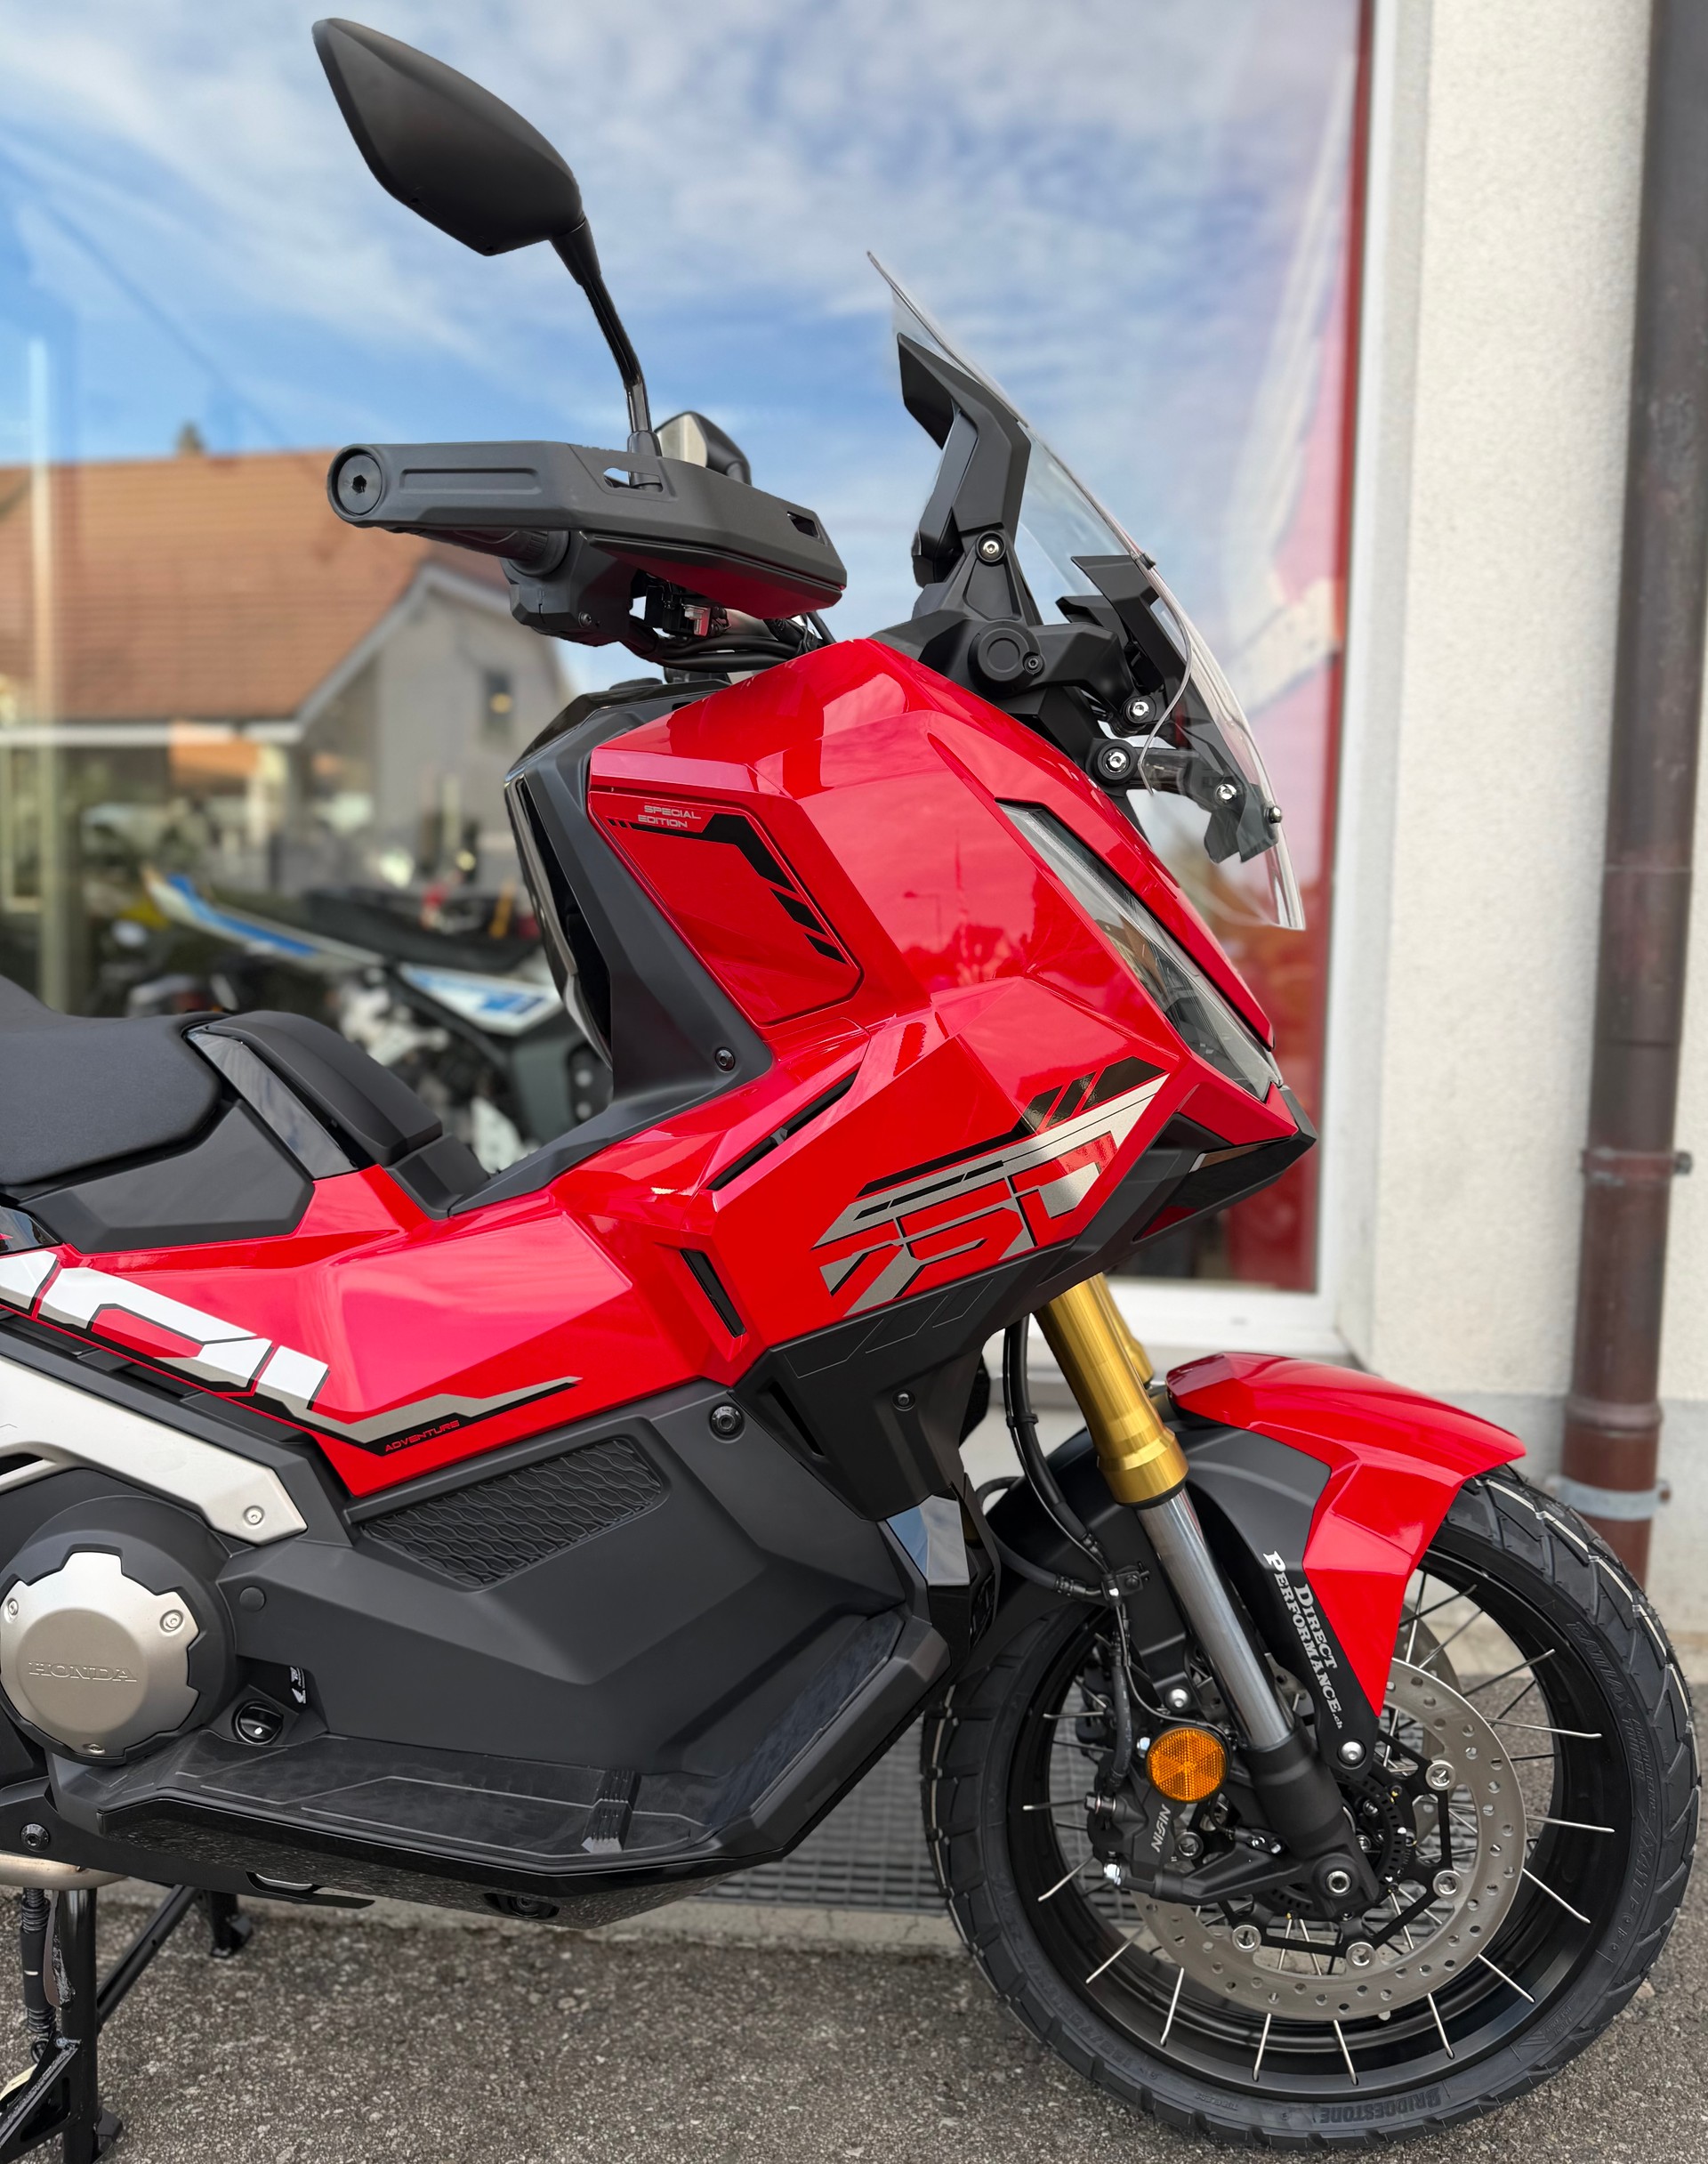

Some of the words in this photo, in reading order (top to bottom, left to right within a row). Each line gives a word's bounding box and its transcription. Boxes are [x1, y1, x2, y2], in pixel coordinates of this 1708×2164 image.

[637, 814, 689, 828] EDITION
[644, 804, 702, 820] SPECIAL
[384, 1419, 461, 1452] ADVENTURE
[1293, 1583, 1338, 1669] DIRECT
[28, 1661, 137, 1683] HONDA
[1319, 2085, 1443, 2124] BRIDGESTONE
